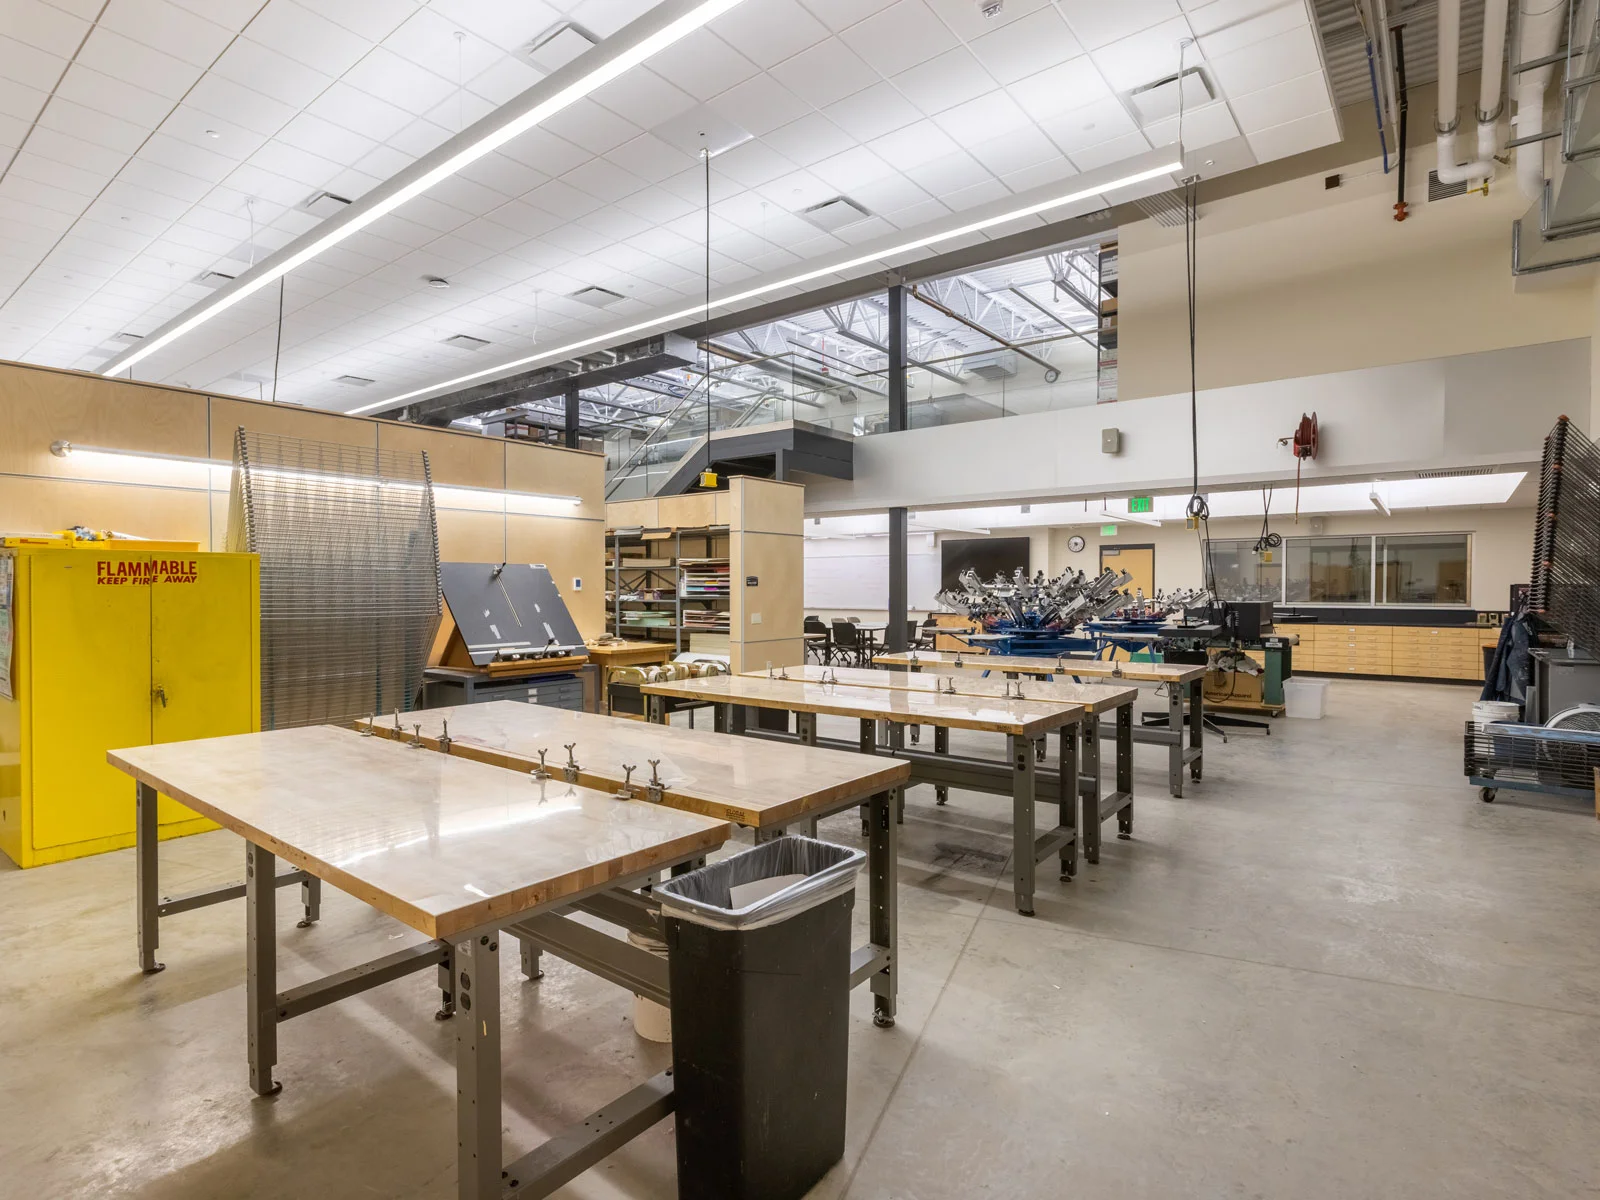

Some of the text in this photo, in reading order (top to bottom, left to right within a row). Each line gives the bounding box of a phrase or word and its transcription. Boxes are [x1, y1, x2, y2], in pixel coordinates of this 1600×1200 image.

[1131, 497, 1150, 512] EXIT
[97, 560, 197, 576] FLAMMABLE
[97, 575, 197, 585] KEEP FIRE AWAY
